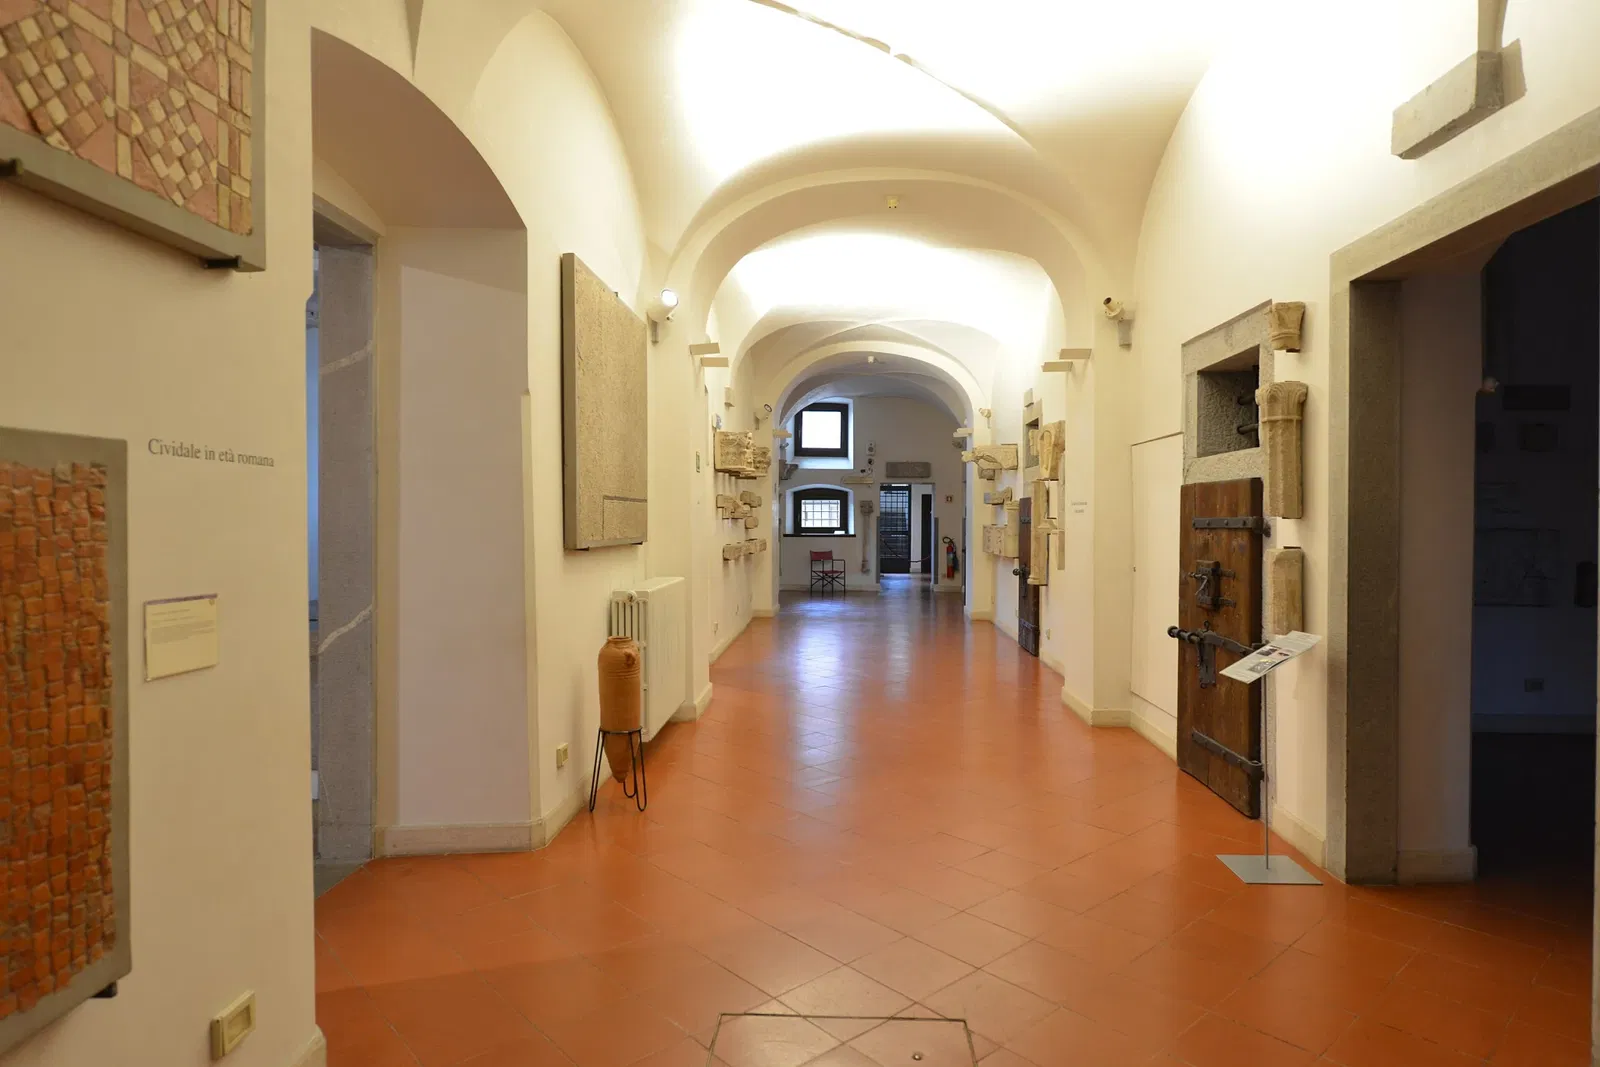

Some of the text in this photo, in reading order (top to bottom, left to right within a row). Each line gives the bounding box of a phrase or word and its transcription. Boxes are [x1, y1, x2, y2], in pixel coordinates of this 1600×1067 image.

[148, 438, 275, 467] Cividale in età romana
